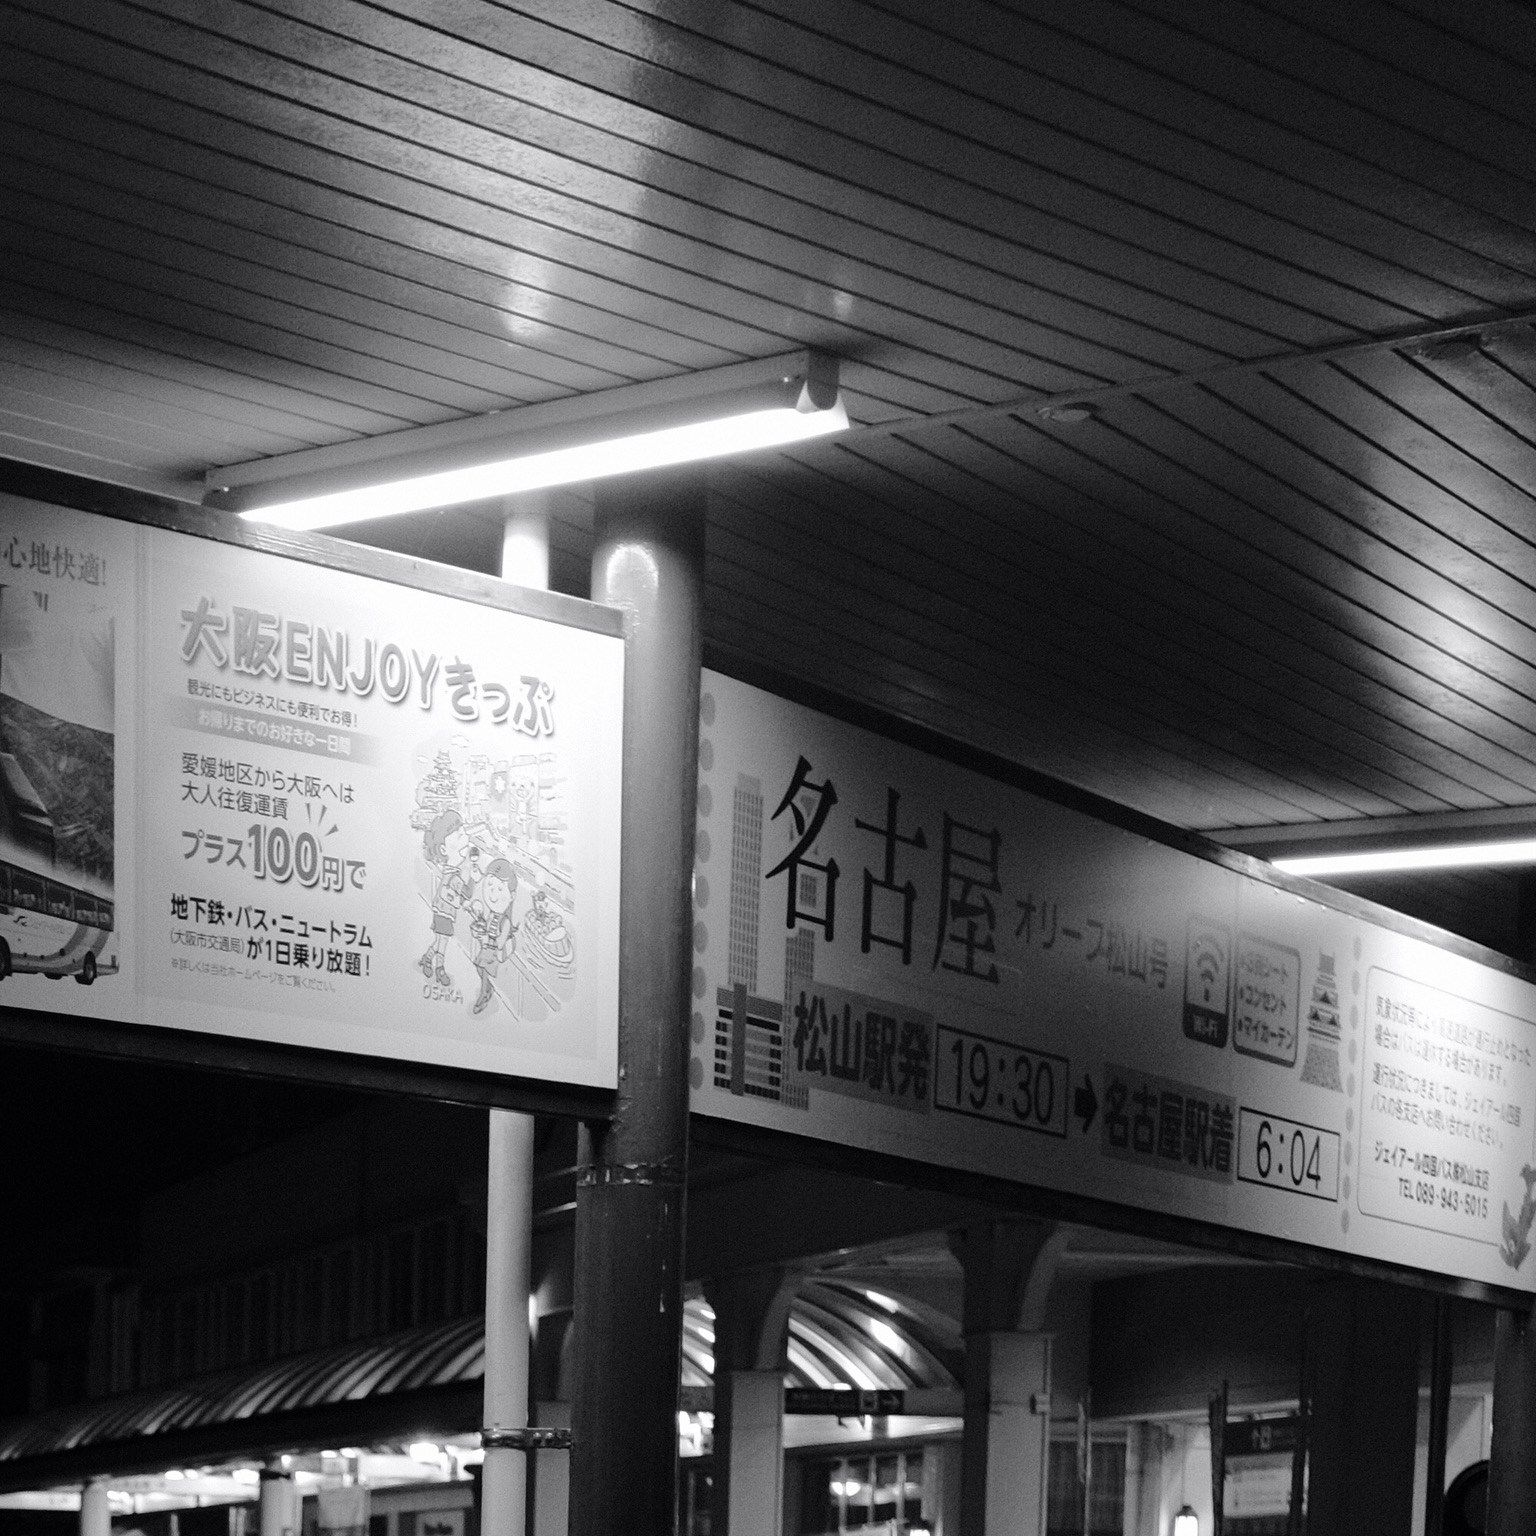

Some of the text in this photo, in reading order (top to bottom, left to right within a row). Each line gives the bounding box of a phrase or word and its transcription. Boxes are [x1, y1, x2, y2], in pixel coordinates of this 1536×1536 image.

[180, 596, 554, 736] 大阪ENJOYきっぷ
[188, 679, 358, 727] 観光にもビジネスにも便利でお得!
[182, 752, 355, 803] 愛媛地区から大阪へは
[182, 781, 288, 820] 大人往復運賃
[182, 824, 367, 892] プラス100円で
[765, 754, 1002, 985] 名古屋
[171, 893, 373, 949] 地下鉄・バス・ニュートラム
[793, 991, 1321, 1190] 松山駅発 19:30 名古屋駅着 6:04
